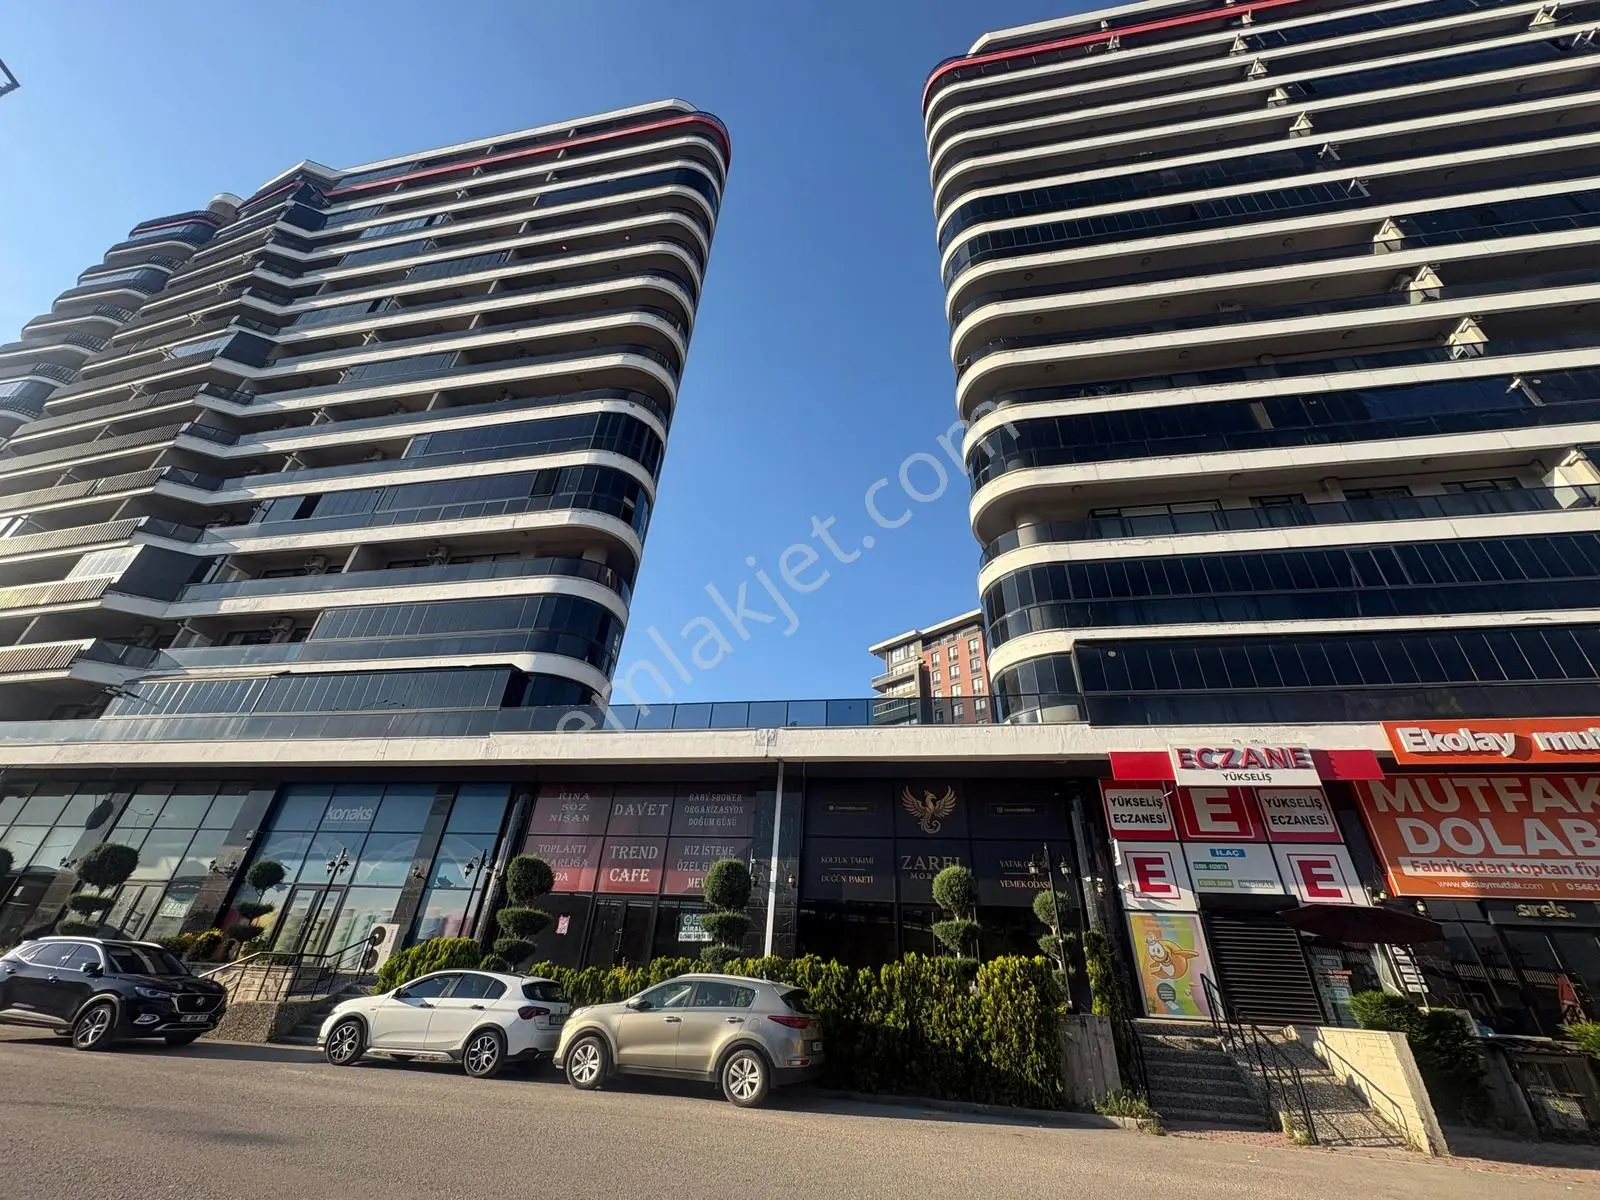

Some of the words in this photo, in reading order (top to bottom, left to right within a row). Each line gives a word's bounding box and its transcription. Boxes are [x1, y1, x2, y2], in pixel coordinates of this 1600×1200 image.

[1396, 727, 1515, 757] Ekolay
[1175, 747, 1312, 769] ECZANE
[1222, 773, 1272, 784] YÜKSELİŞ
[1110, 796, 1163, 809] YÜKSELİŞ
[1368, 777, 1600, 813] MUTFAK
[613, 802, 669, 816] DAVET
[1188, 787, 1241, 833] E
[1264, 797, 1323, 810] YÜKSELİŞ
[325, 805, 373, 821] konaks
[1113, 814, 1167, 825] ECZANESİ
[1270, 815, 1329, 826] ECZANESİ
[1396, 817, 1600, 856] DOLAB
[610, 845, 658, 860] TREND
[684, 845, 700, 856] KIZ
[609, 868, 651, 882] CAFE
[1132, 857, 1172, 893] E
[1410, 860, 1508, 874] Fabrikadan
[1510, 862, 1574, 877] toptan
[1297, 860, 1343, 898] E
